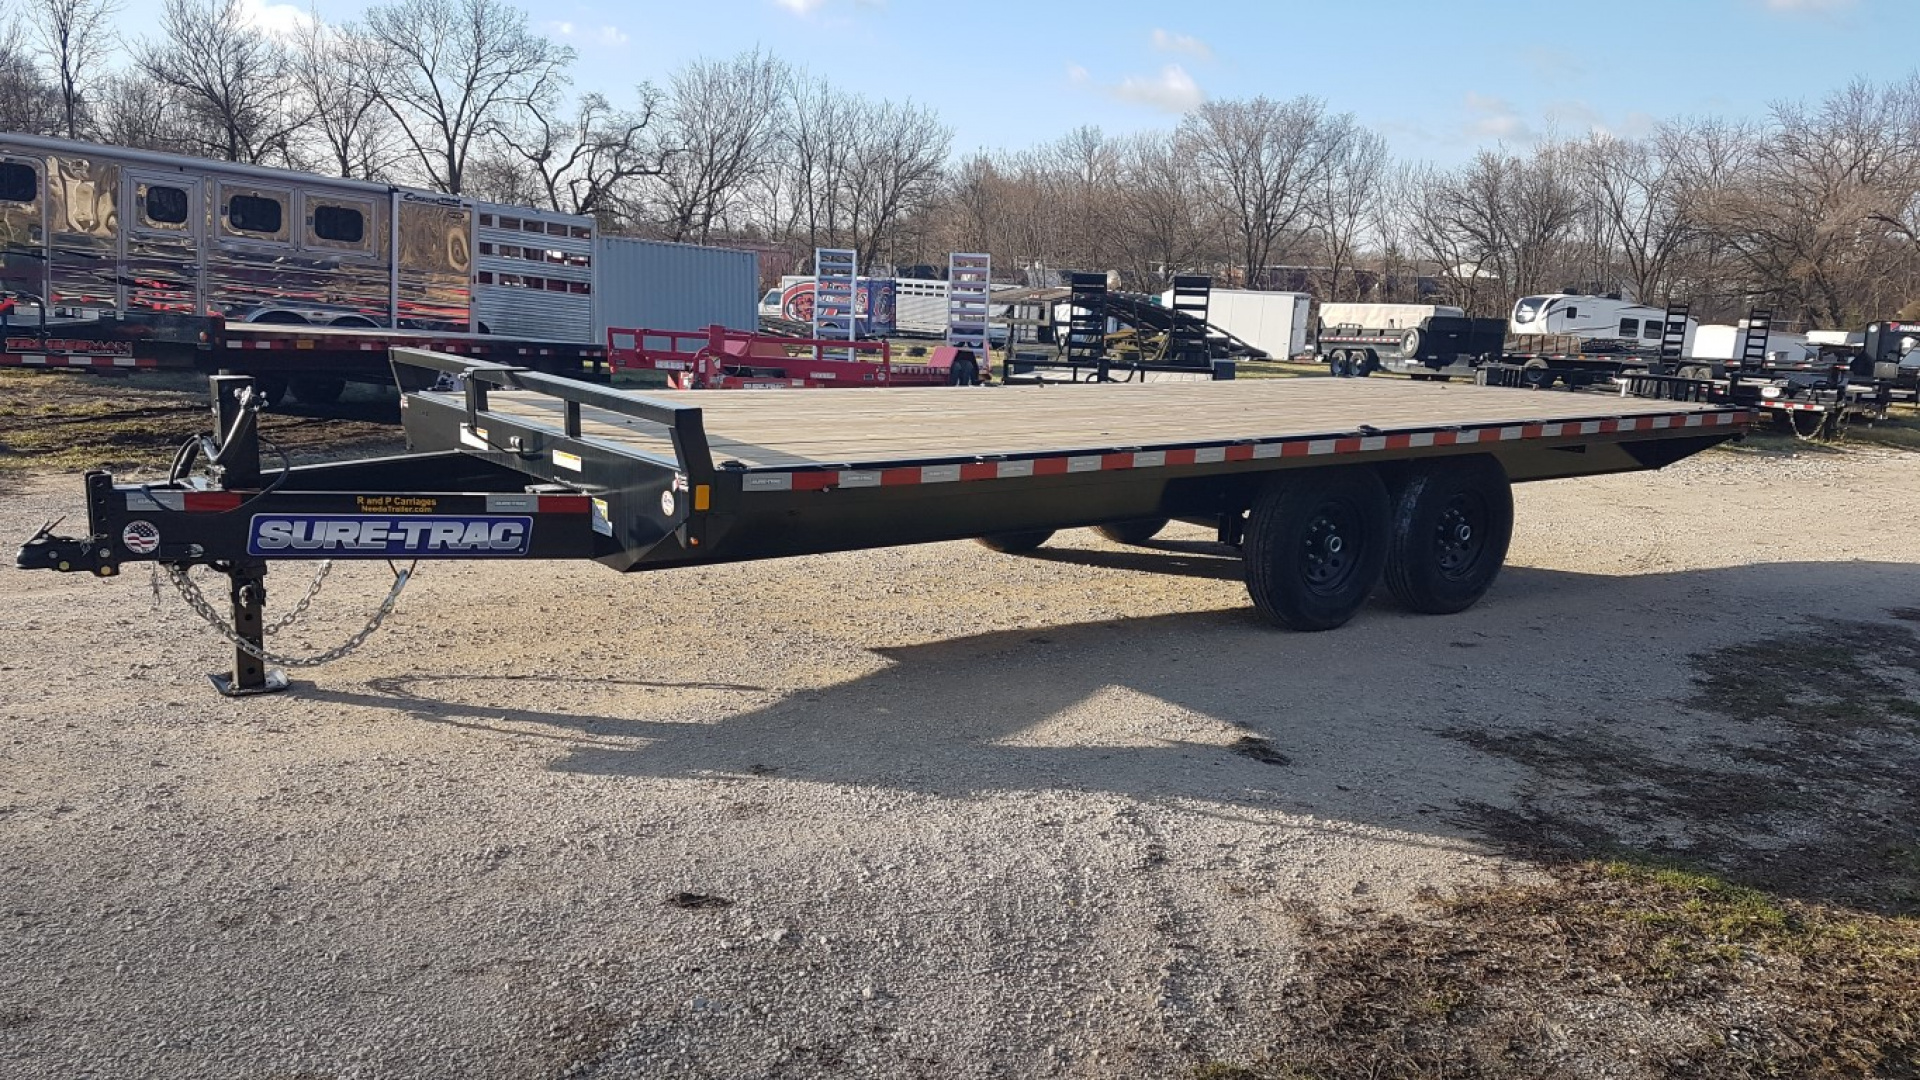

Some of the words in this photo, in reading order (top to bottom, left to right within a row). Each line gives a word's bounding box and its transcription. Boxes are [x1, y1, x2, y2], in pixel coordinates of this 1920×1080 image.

[357, 496, 364, 504] R
[394, 497, 436, 506] Carriages
[257, 520, 524, 550] SURE-TRAC
